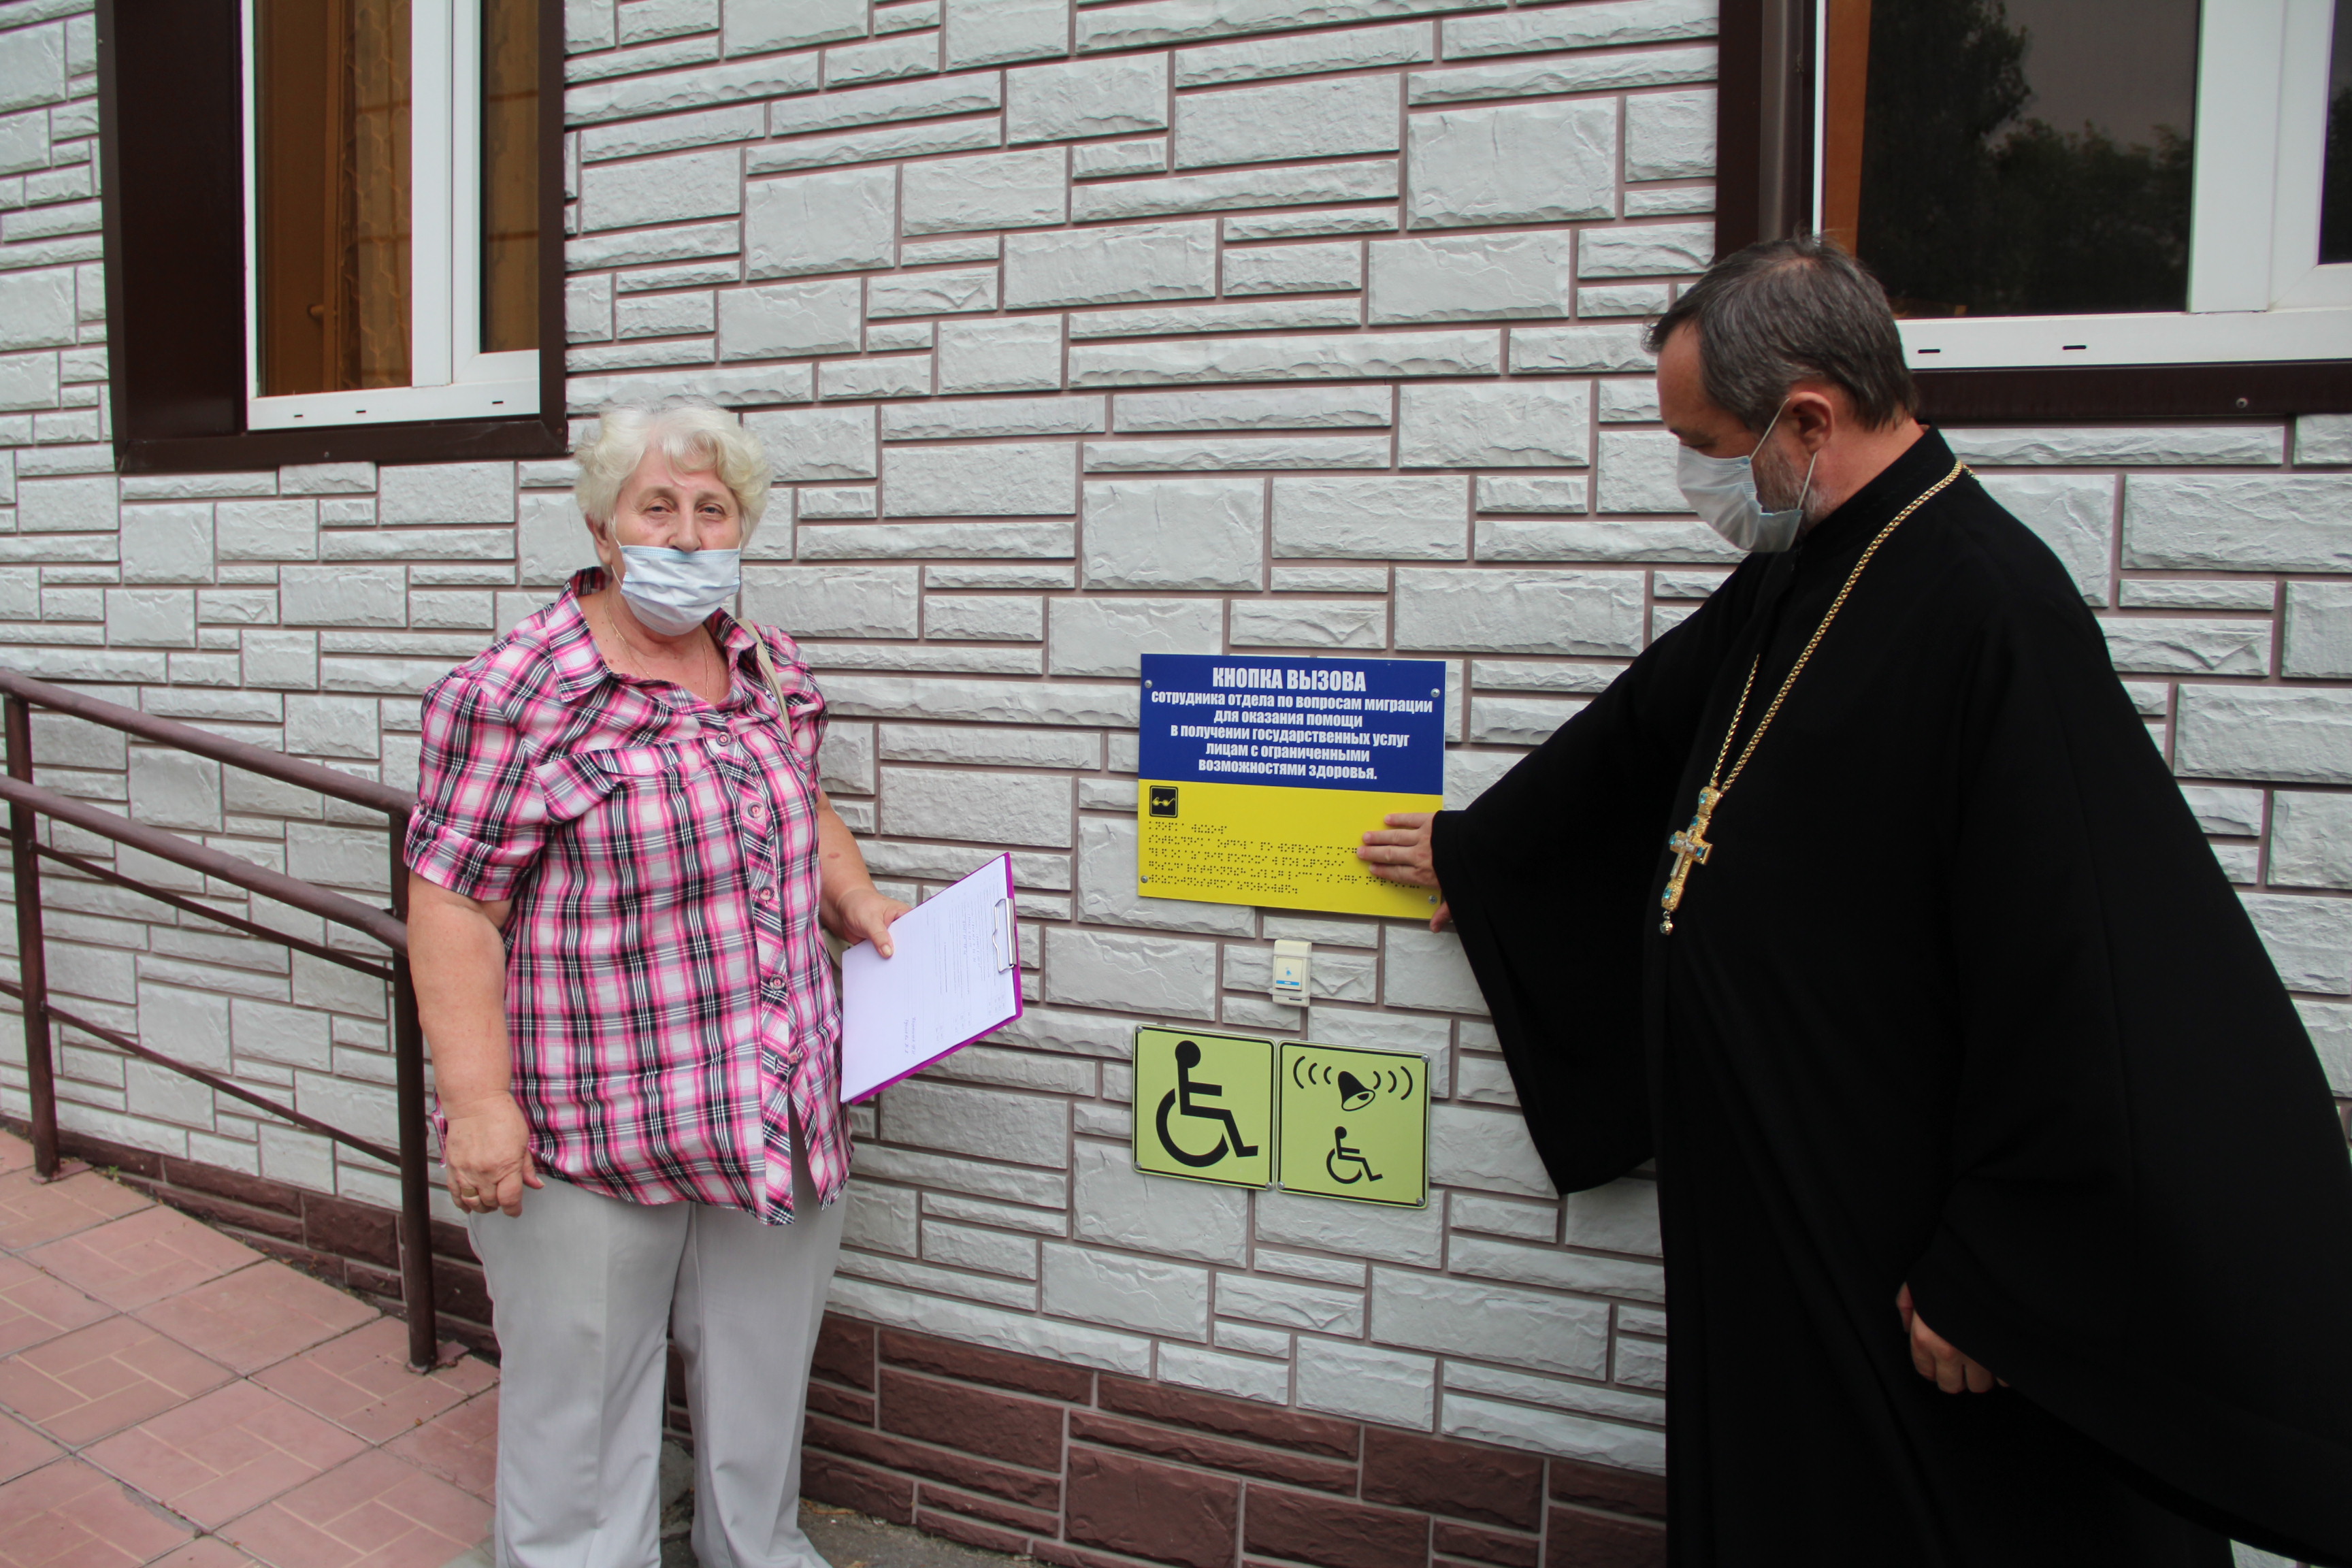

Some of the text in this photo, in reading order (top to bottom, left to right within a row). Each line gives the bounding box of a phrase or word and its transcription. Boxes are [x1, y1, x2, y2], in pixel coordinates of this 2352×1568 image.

[1213, 668, 1366, 691] КНОПКА ВЫЗОВА
[1152, 691, 1433, 714] сотрудника отдела по вопросам миграции
[1214, 710, 1362, 729] для оказания помощи
[1171, 725, 1409, 747] в получении государственных услуг
[1206, 743, 1369, 762] лицам с ограниченными
[1199, 760, 1377, 779] возможностями здоровья.
